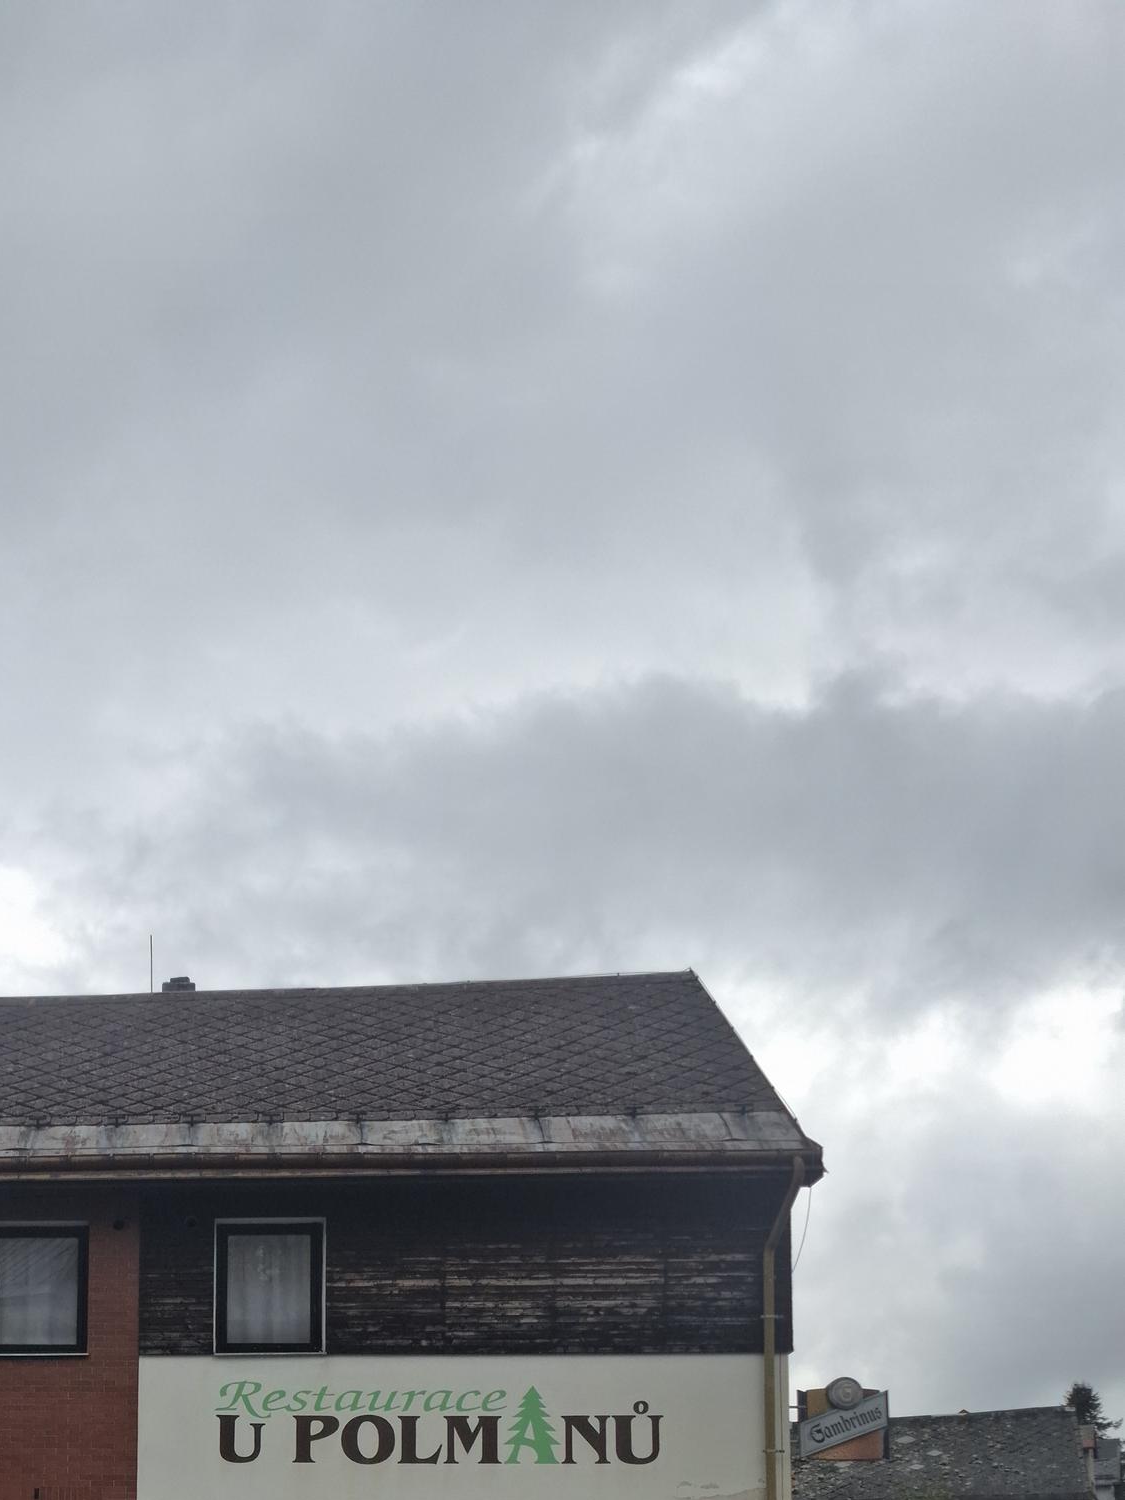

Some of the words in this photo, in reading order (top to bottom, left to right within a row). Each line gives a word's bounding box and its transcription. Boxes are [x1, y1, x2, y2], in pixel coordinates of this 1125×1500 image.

[214, 1381, 507, 1418] Restaurace
[215, 1415, 266, 1464] U
[292, 1385, 664, 1465] POLMANŮ
[810, 1407, 882, 1444] Gambrinus
